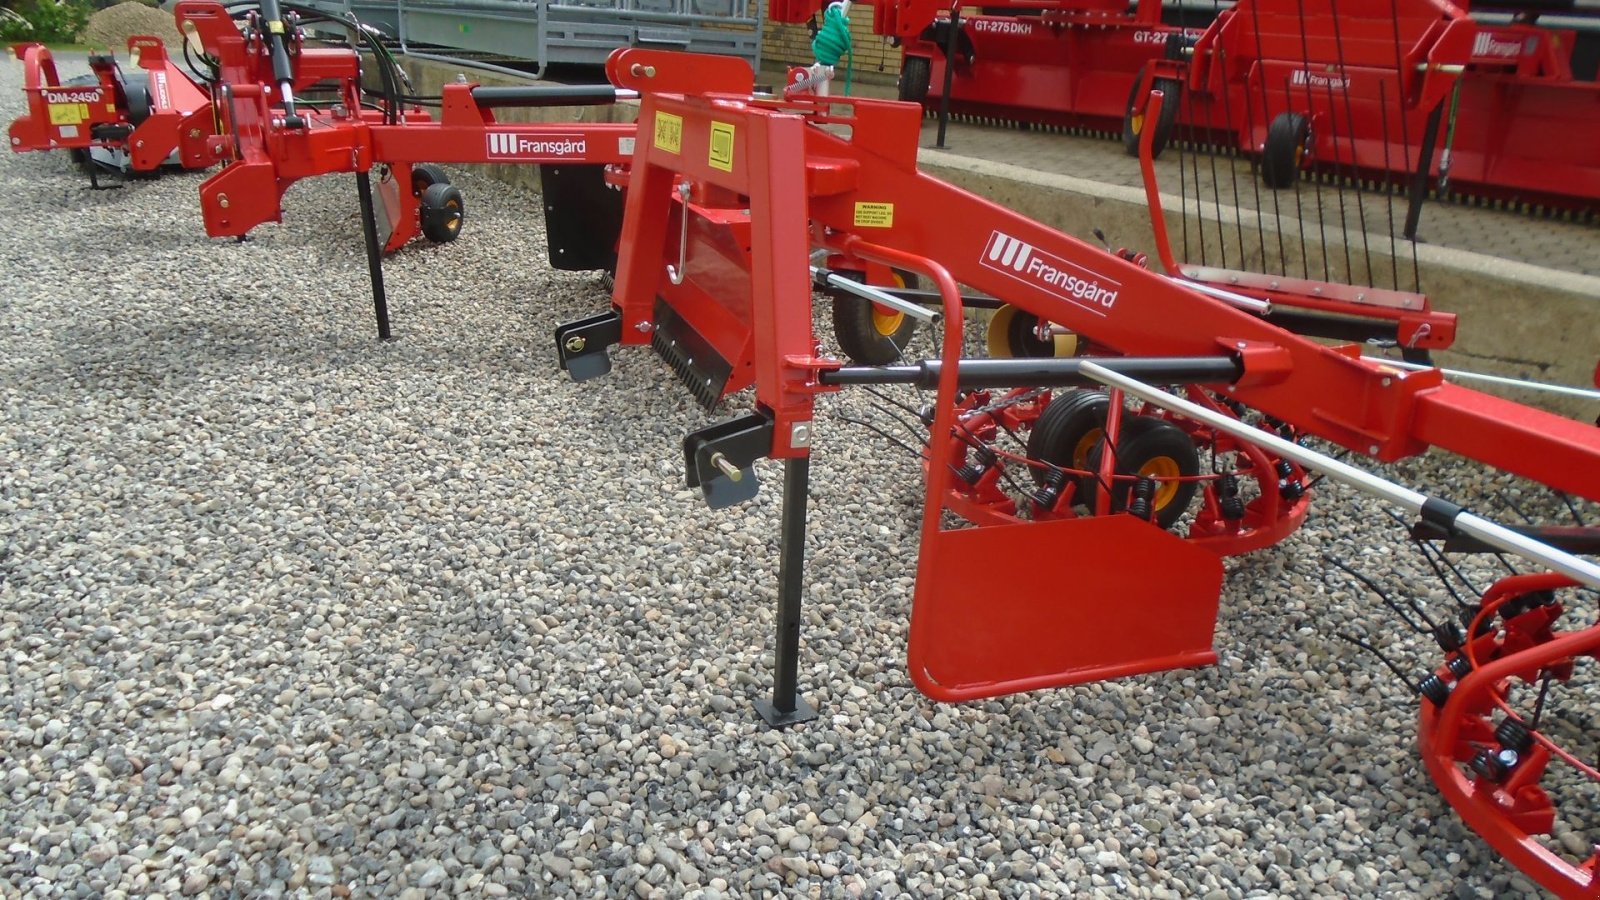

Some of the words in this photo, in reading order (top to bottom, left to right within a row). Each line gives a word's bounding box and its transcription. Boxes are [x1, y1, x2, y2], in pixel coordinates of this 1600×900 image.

[1133, 31, 1169, 44] GT-27
[47, 92, 100, 104] DM-2450
[519, 139, 586, 155] Fransgård
[1026, 257, 1118, 308] Fransgård
